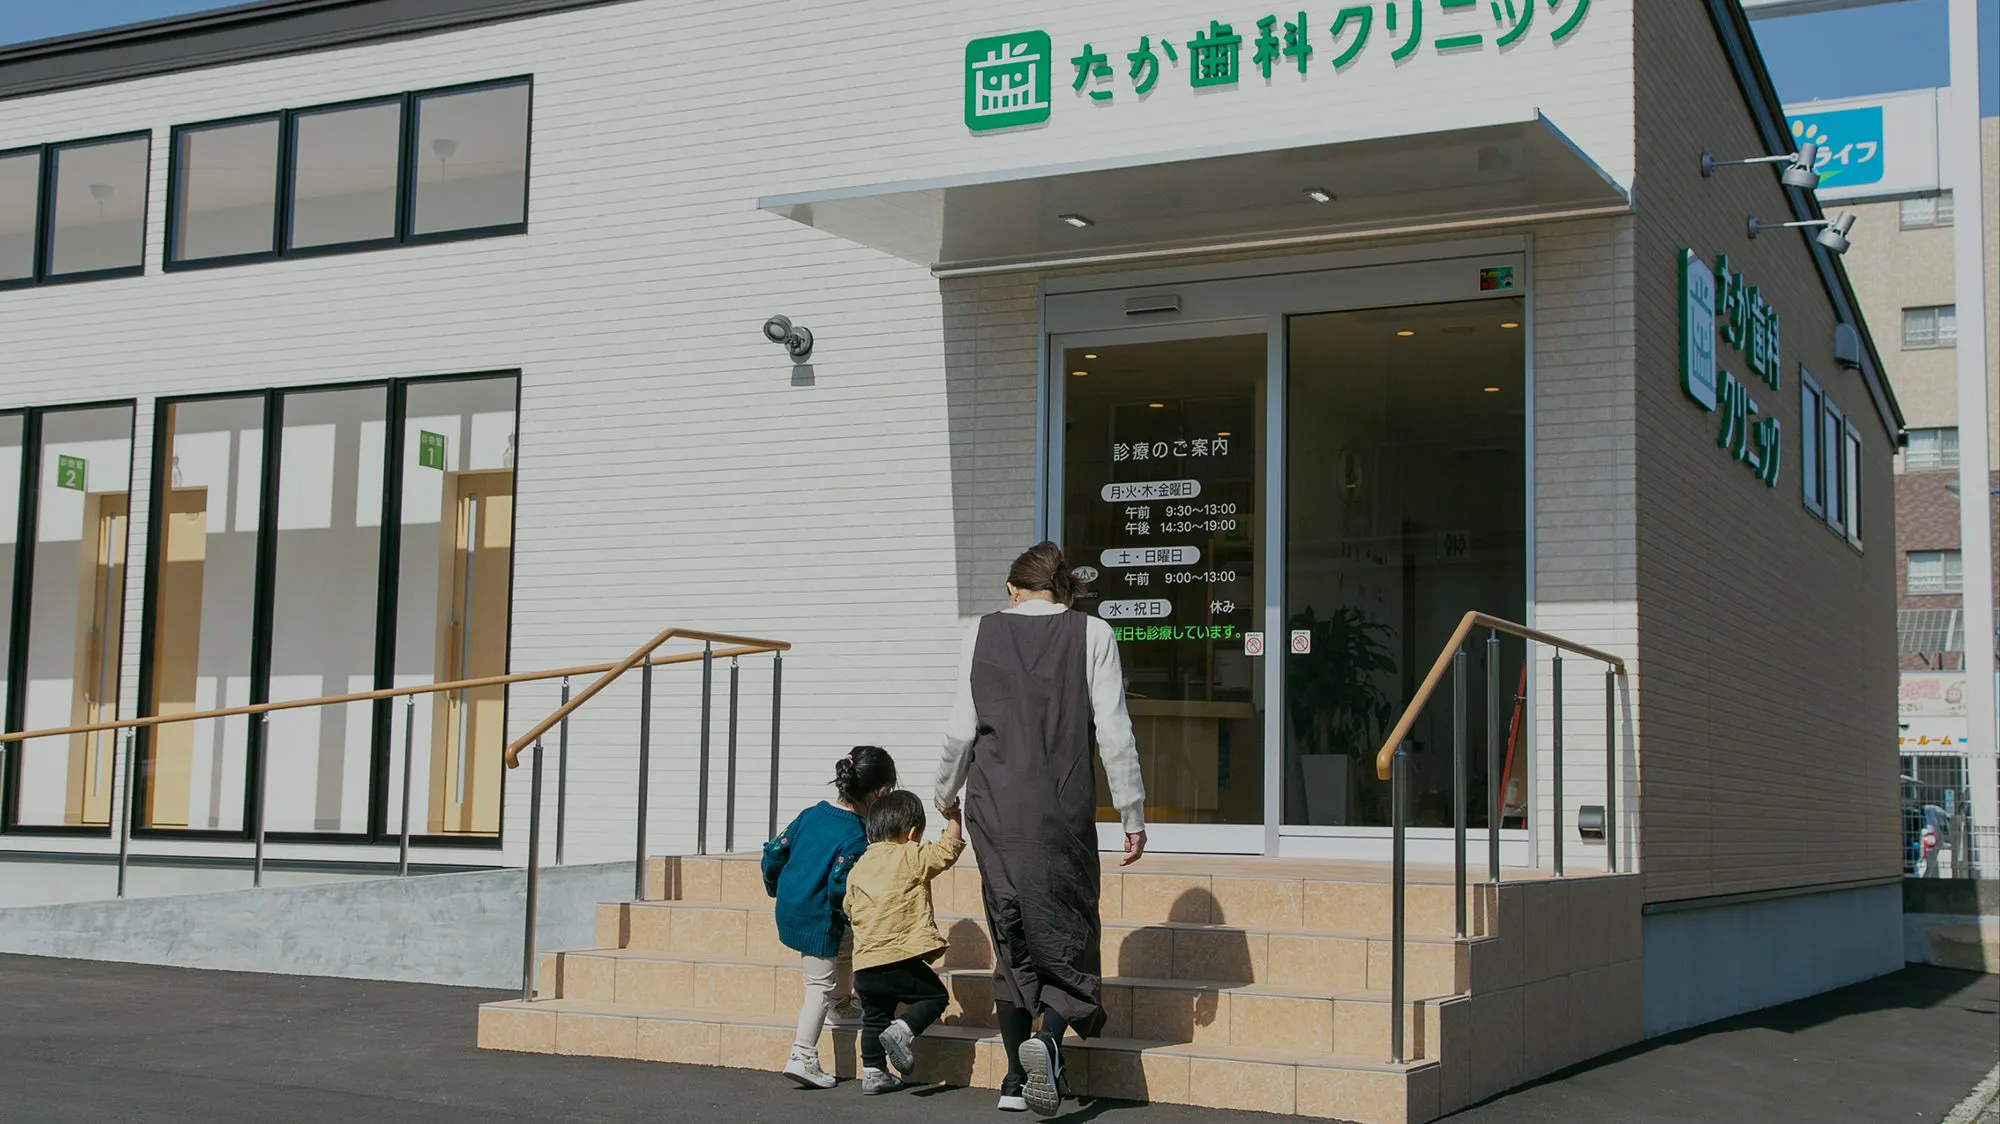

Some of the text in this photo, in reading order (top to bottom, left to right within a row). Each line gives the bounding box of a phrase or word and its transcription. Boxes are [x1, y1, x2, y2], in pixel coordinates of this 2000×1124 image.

[1714, 254, 1780, 391] たか歯科
[1717, 370, 1781, 488] クリニック
[428, 447, 434, 465] 1
[1113, 437, 1228, 462] 診療のご案内
[65, 470, 76, 487] 2
[1110, 482, 1192, 499] 月・火・木・金曜日
[1125, 505, 1150, 519] 午前
[1125, 521, 1150, 535] 午後
[1118, 549, 1182, 564] 土・日曜日
[1124, 572, 1149, 586] 午前
[1109, 600, 1235, 617] 水・祝日 休み
